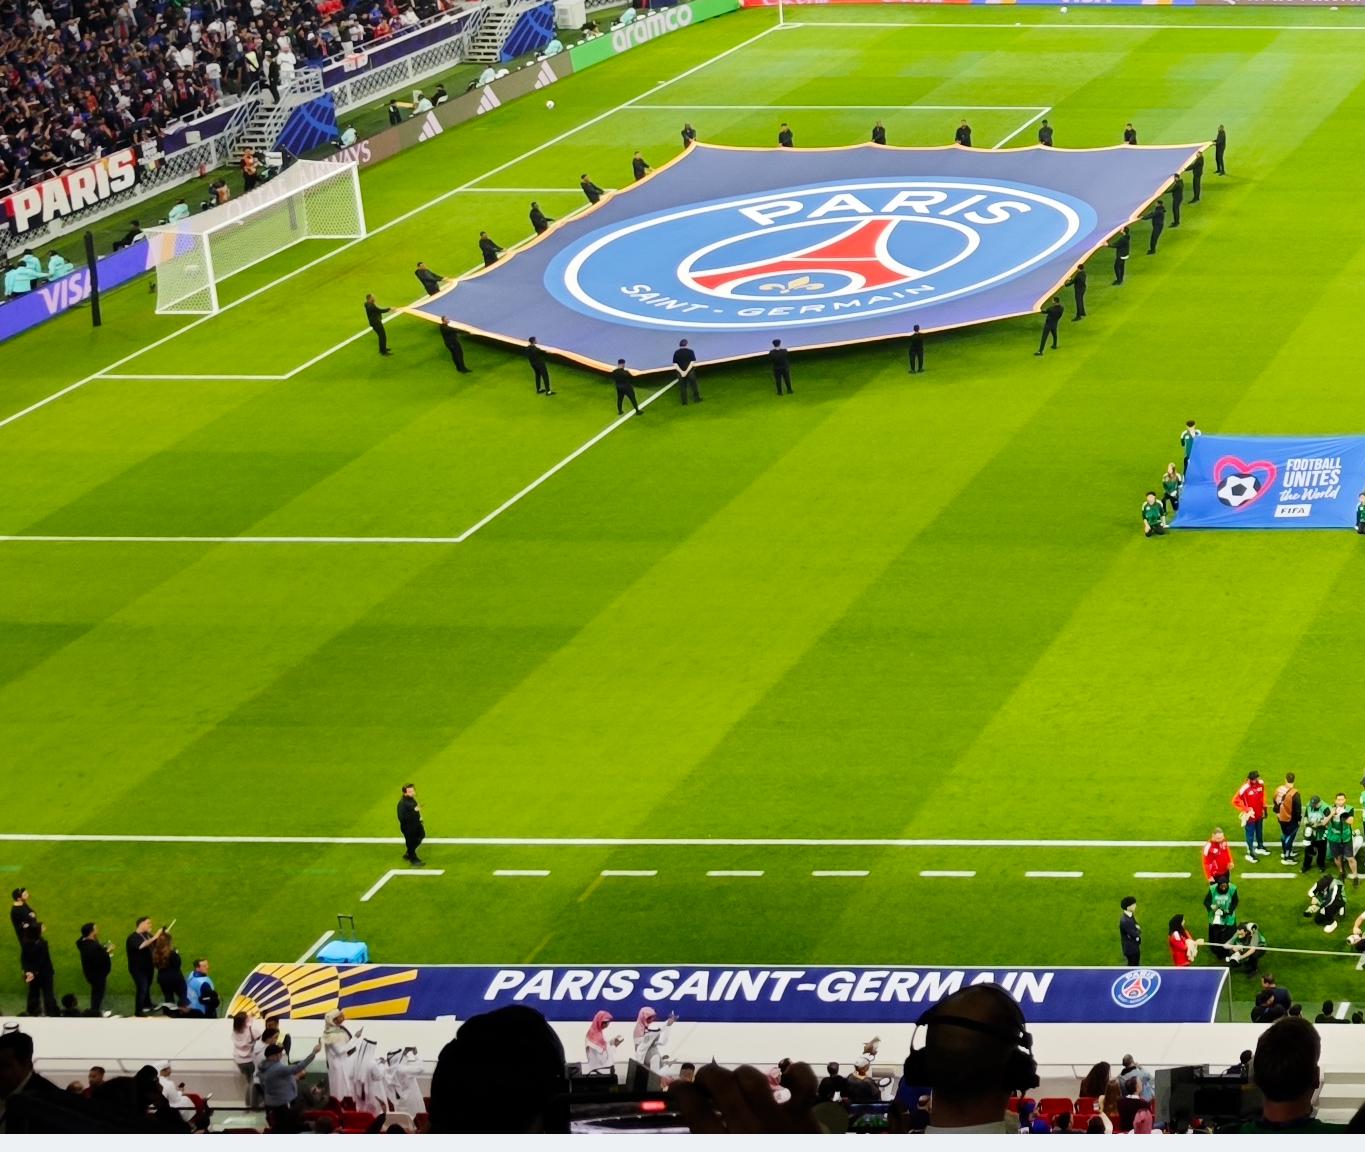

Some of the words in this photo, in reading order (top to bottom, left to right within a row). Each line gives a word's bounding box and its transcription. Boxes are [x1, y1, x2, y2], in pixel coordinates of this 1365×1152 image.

[611, 4, 693, 53] aramco
[10, 149, 137, 233] PARIS
[738, 190, 1032, 228] PARIS
[617, 283, 704, 316] SAINT
[1282, 469, 1341, 488] UNITES
[1286, 457, 1342, 472] FOOTBALL
[1279, 488, 1301, 502] the
[1301, 485, 1341, 501] World
[484, 969, 636, 1001] PARIS
